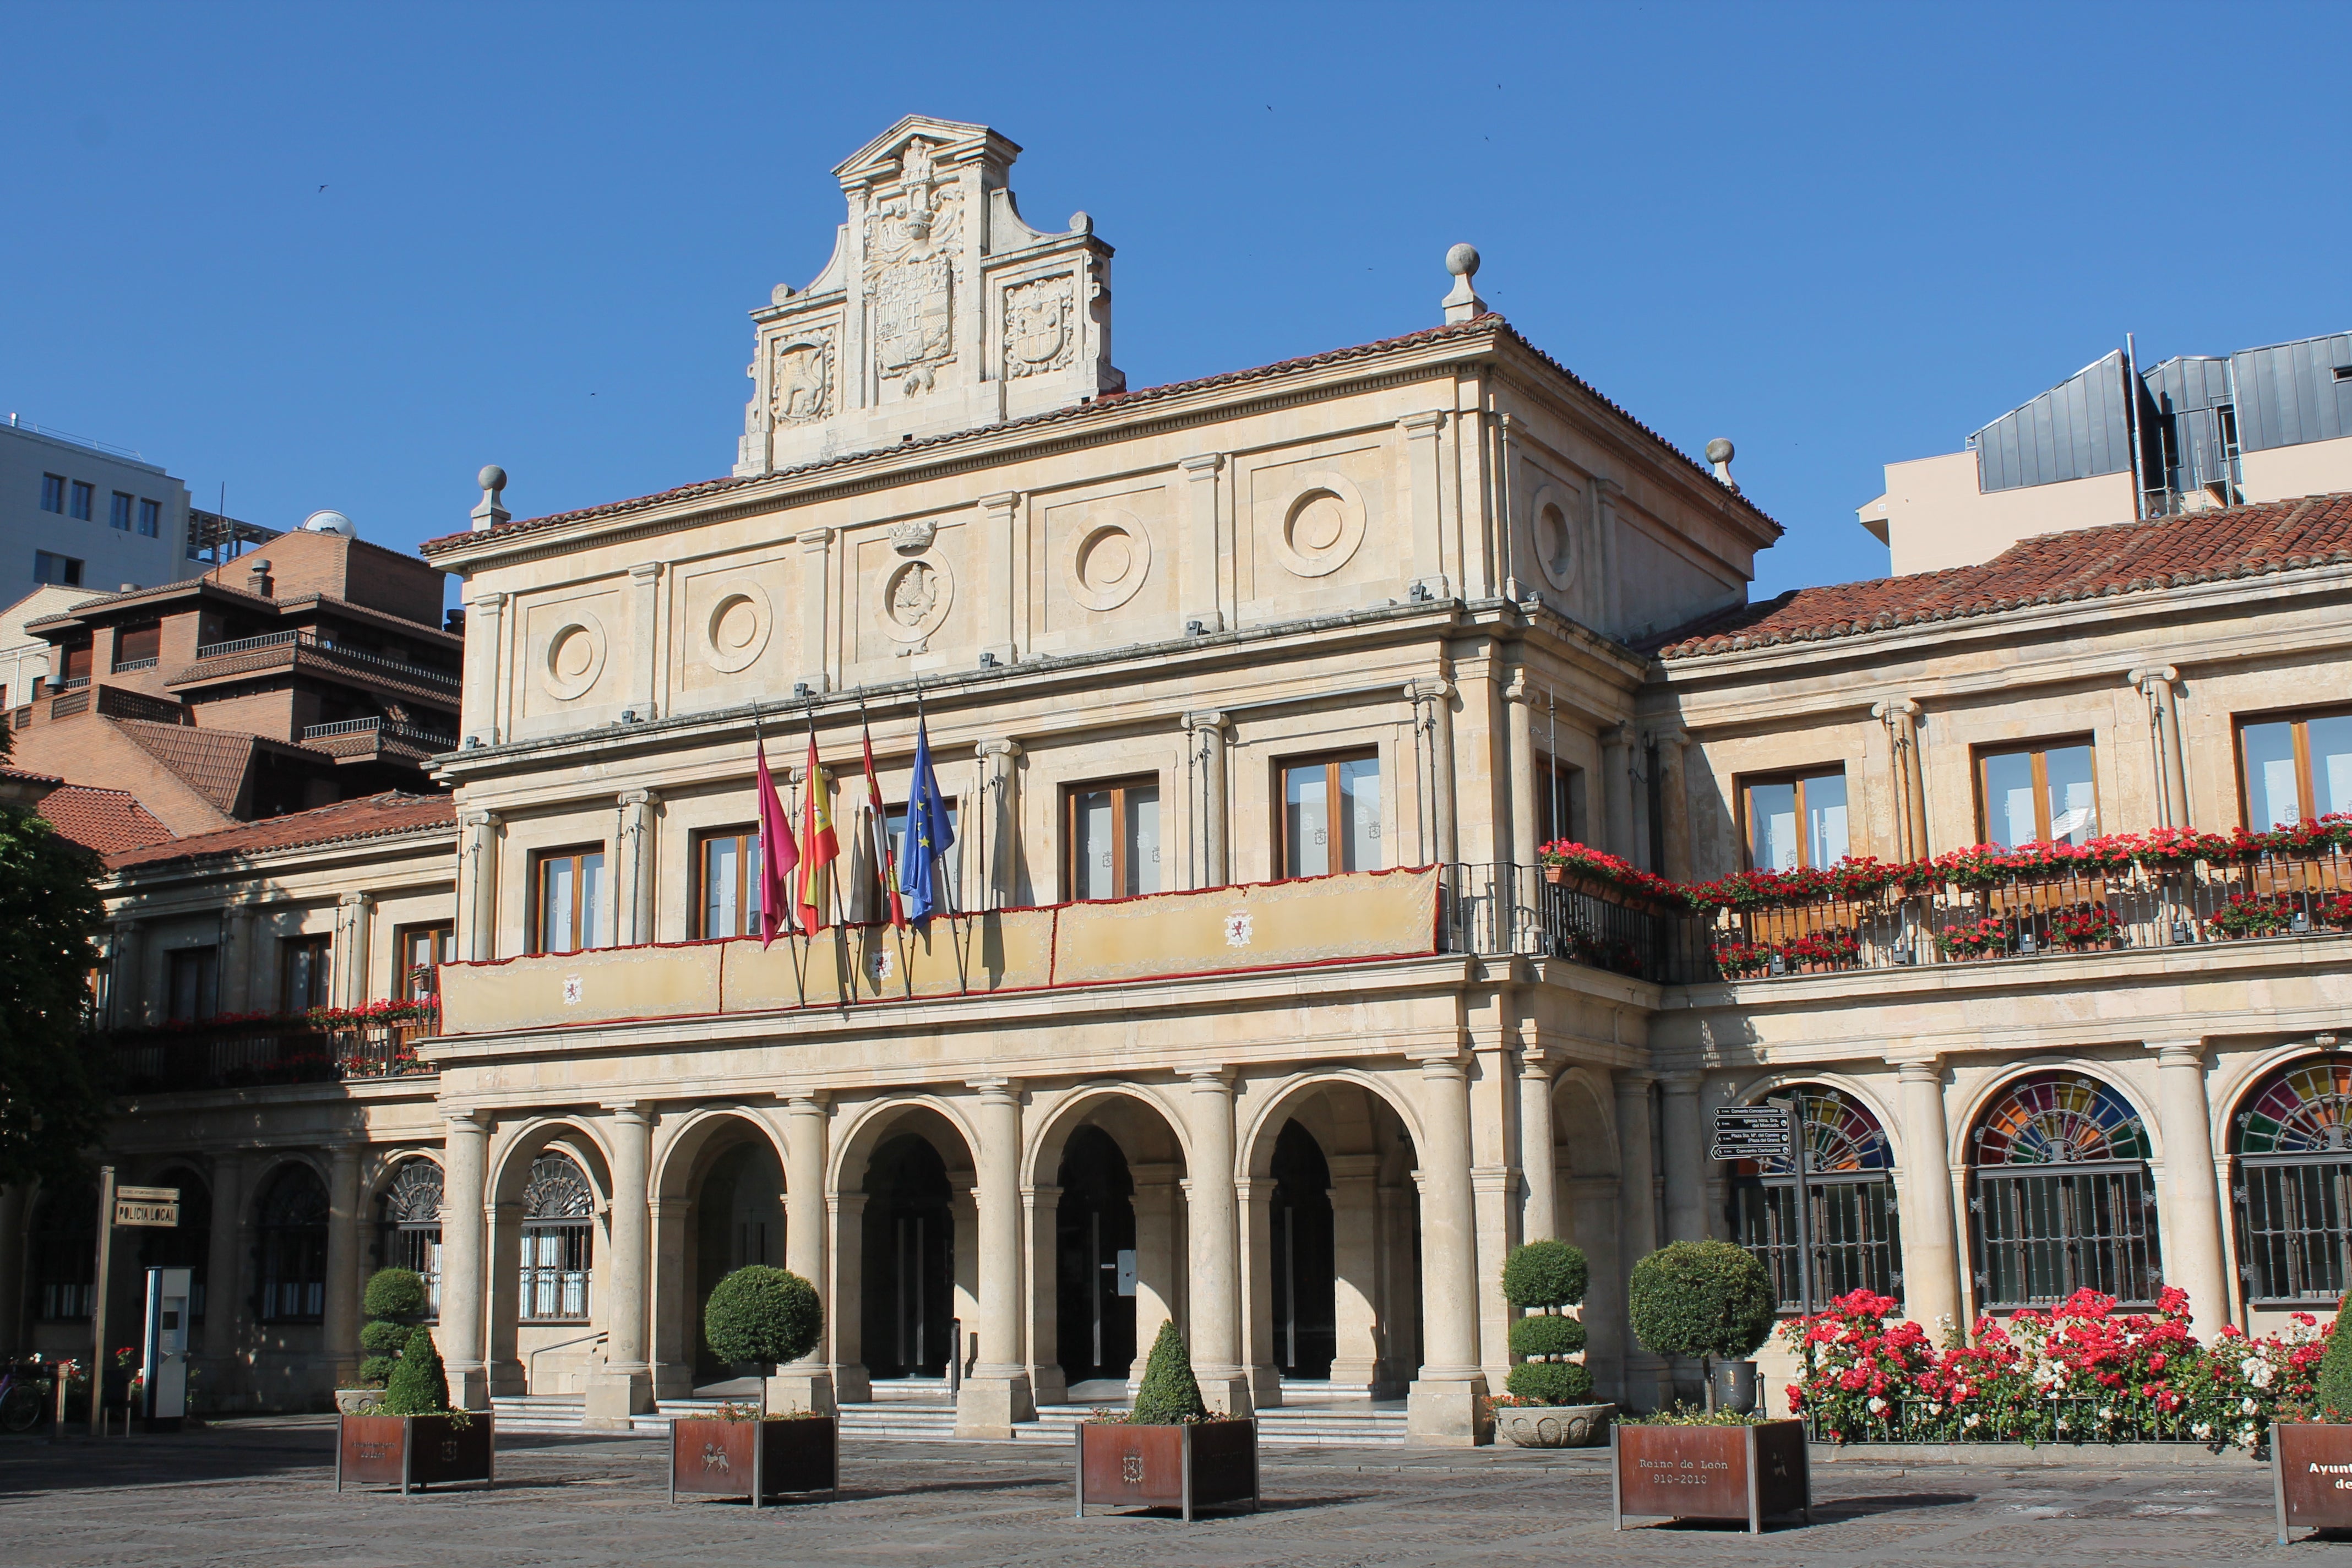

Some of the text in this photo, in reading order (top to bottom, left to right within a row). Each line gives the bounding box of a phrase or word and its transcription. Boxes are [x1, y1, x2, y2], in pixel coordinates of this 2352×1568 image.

[151, 1208, 175, 1221] LOCAL
[1640, 1460, 1728, 1469] Reino de León
[1654, 1474, 1707, 1484] 910-2010
[2335, 1478, 2352, 1490] de
